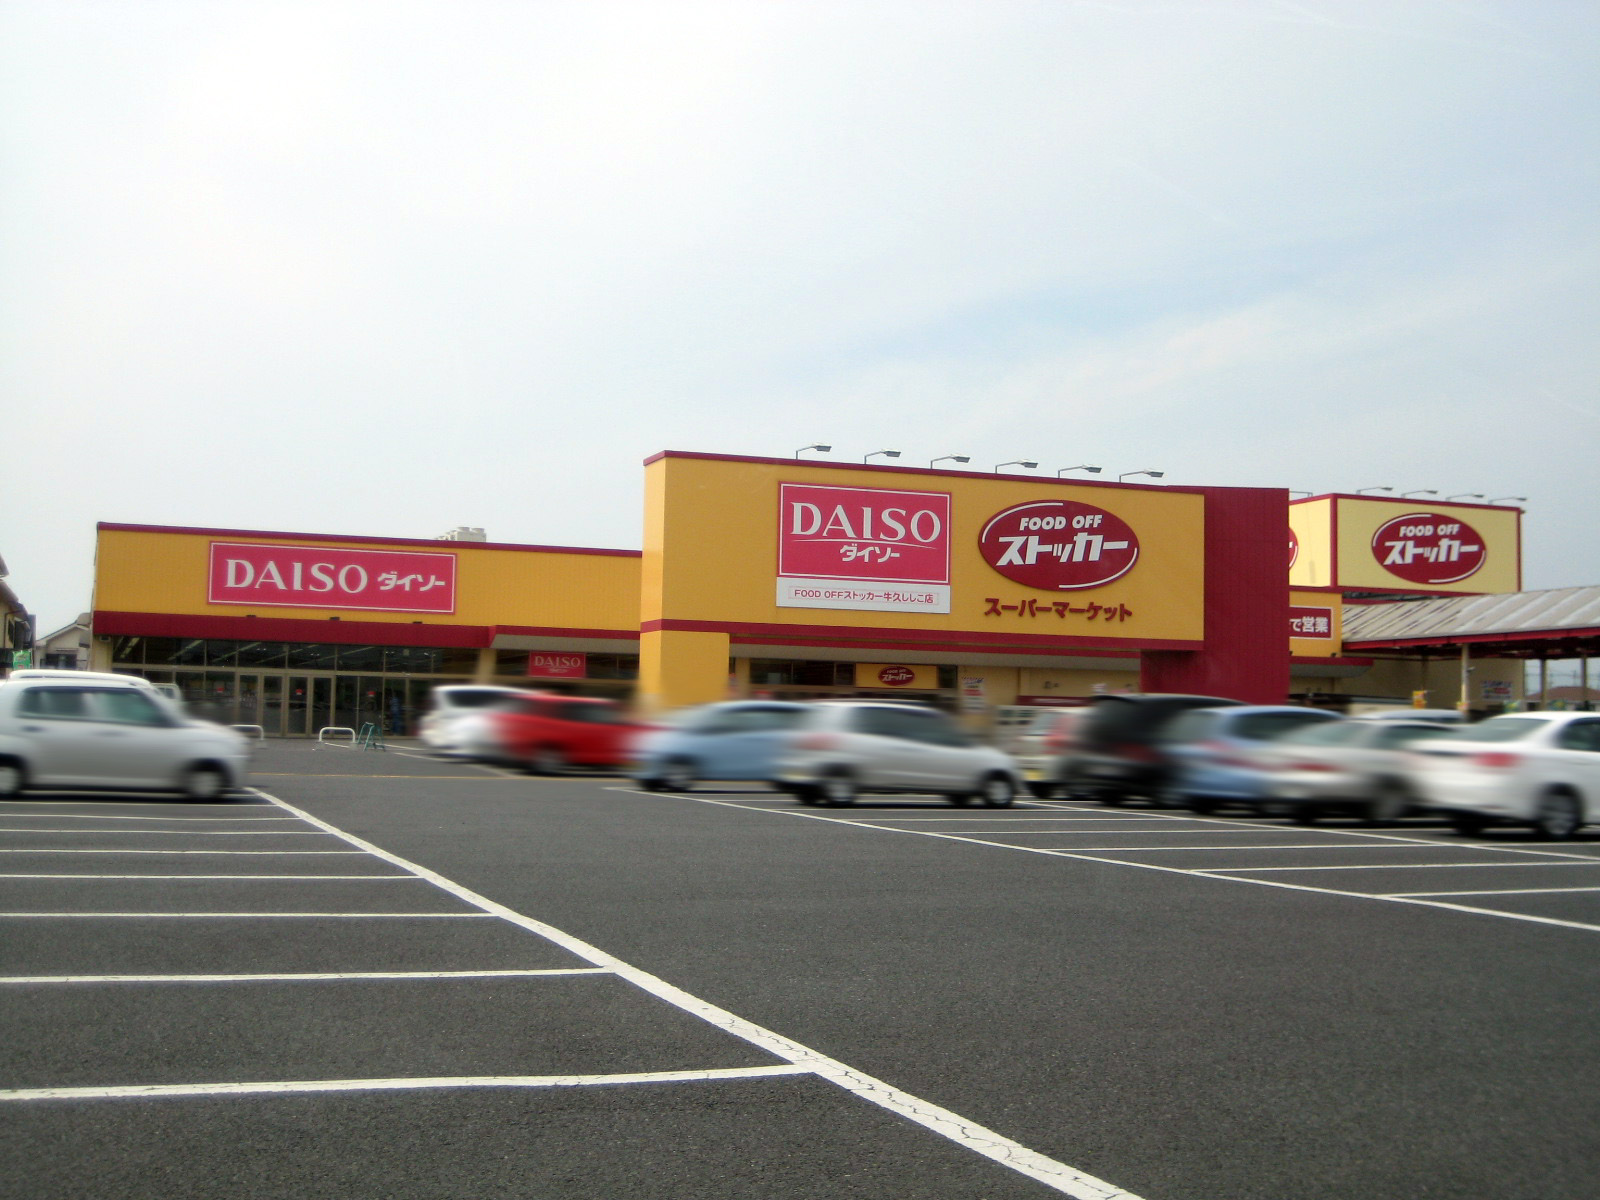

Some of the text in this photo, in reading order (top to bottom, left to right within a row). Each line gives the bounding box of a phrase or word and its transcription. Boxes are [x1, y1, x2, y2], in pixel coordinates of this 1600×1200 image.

[790, 502, 941, 543] DAISO
[1019, 515, 1103, 531] FOOD OFF
[1400, 524, 1460, 538] FOOD OFF
[840, 543, 900, 563] ダイソー
[996, 532, 1129, 566] ストッカー
[1383, 538, 1479, 566] ストッカー
[224, 558, 446, 594] DAISO ダイソー
[794, 589, 822, 598] FOOD
[984, 598, 1133, 623] スーパーマーケット
[534, 655, 581, 668] DAISO
